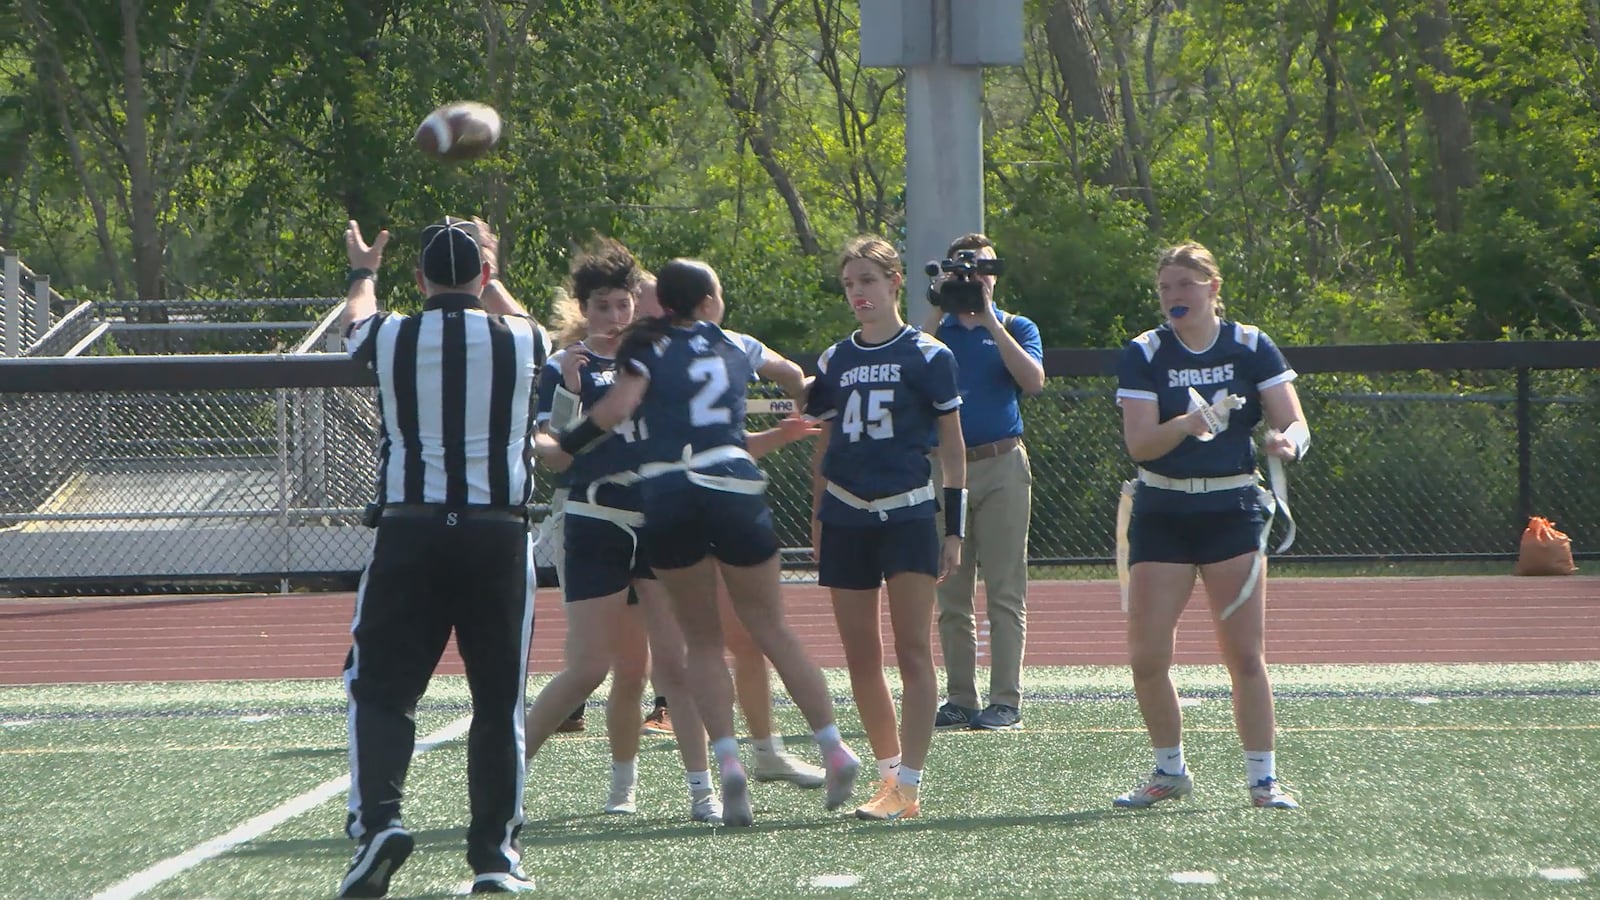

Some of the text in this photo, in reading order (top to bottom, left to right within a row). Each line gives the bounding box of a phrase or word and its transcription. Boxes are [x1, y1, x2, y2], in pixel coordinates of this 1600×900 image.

[840, 364, 902, 388] SABERS
[1168, 363, 1234, 388] SABERS
[688, 356, 732, 427] 2
[842, 389, 895, 443] 45
[446, 512, 458, 526] S
